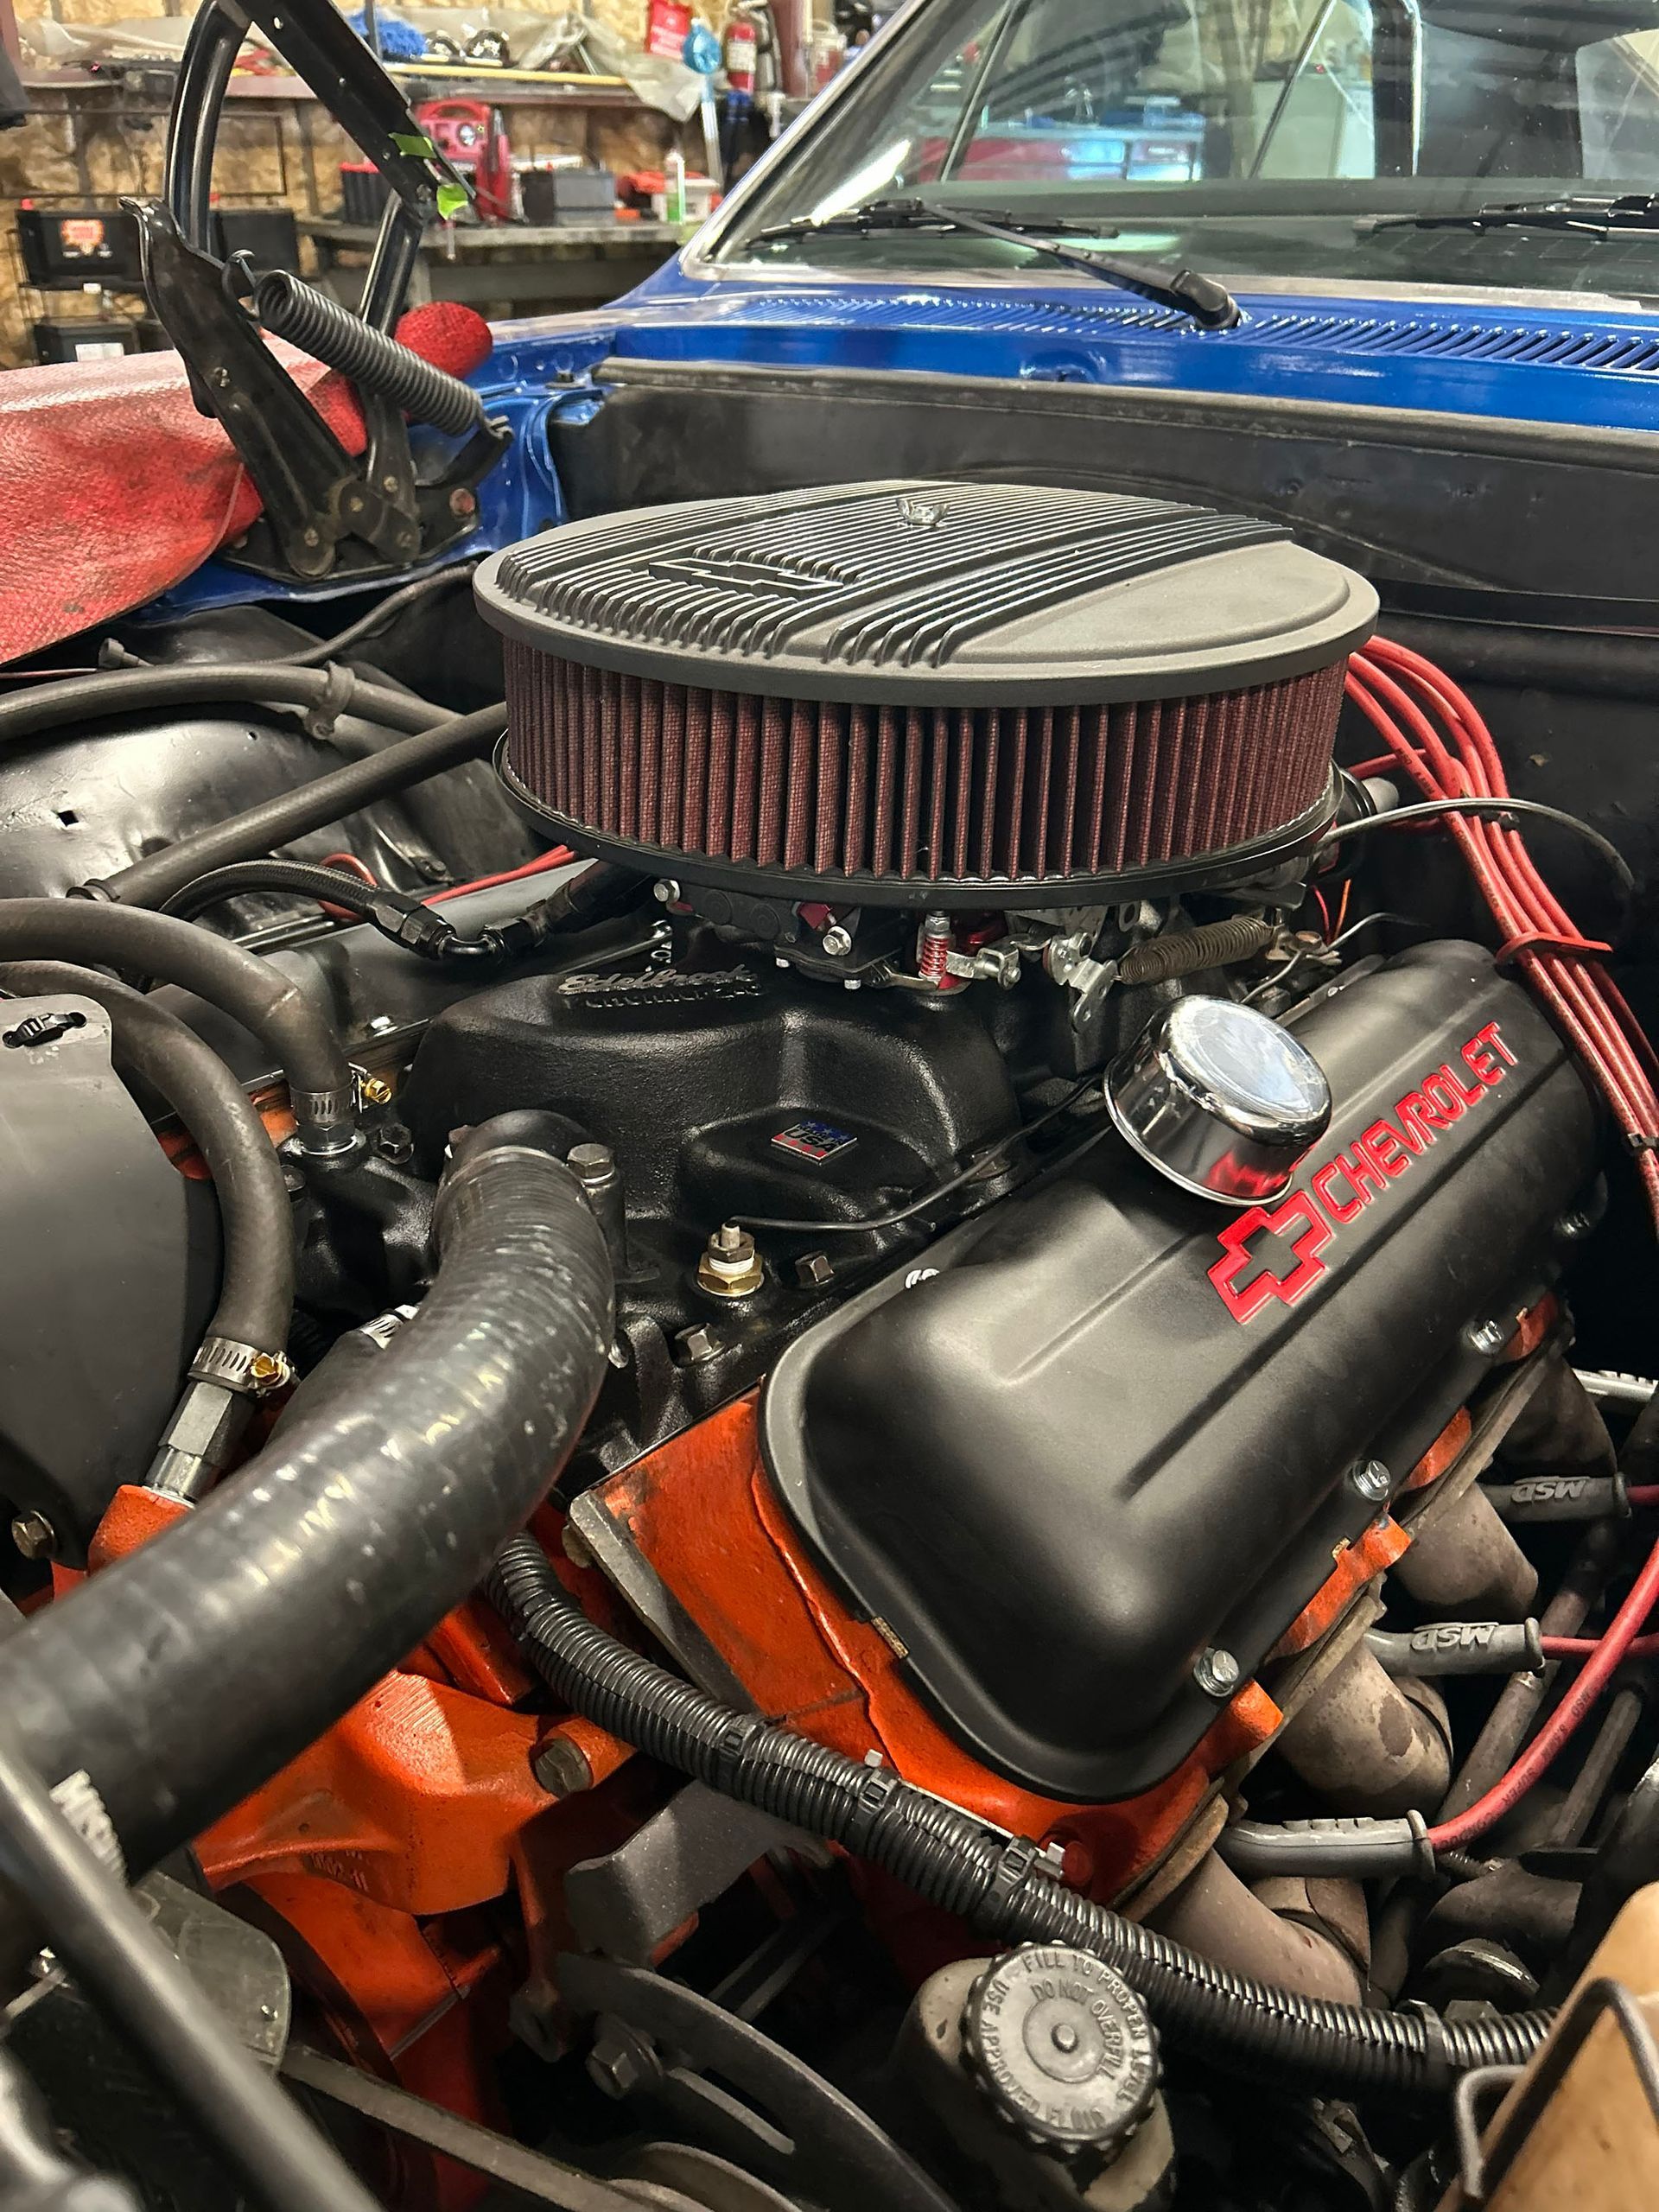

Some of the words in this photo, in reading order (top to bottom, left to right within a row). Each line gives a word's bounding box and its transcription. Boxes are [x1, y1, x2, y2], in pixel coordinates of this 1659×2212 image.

[558, 963, 758, 995] Edelbrock
[1312, 1020, 1518, 1224] CHEVROLET
[1511, 1478, 1587, 1504] MSD
[1410, 1624, 1496, 1653] MSD
[983, 1979, 1011, 2017] USE
[1022, 1950, 1065, 1974] FILL
[1072, 1954, 1095, 1975] TO
[1098, 1970, 1148, 2040] PROPER
[1030, 1979, 1056, 2002] DO
[1058, 1980, 1095, 2005] NOT
[1090, 1998, 1124, 2081] OVERFILL
[981, 2019, 1041, 2118] APPROVED
